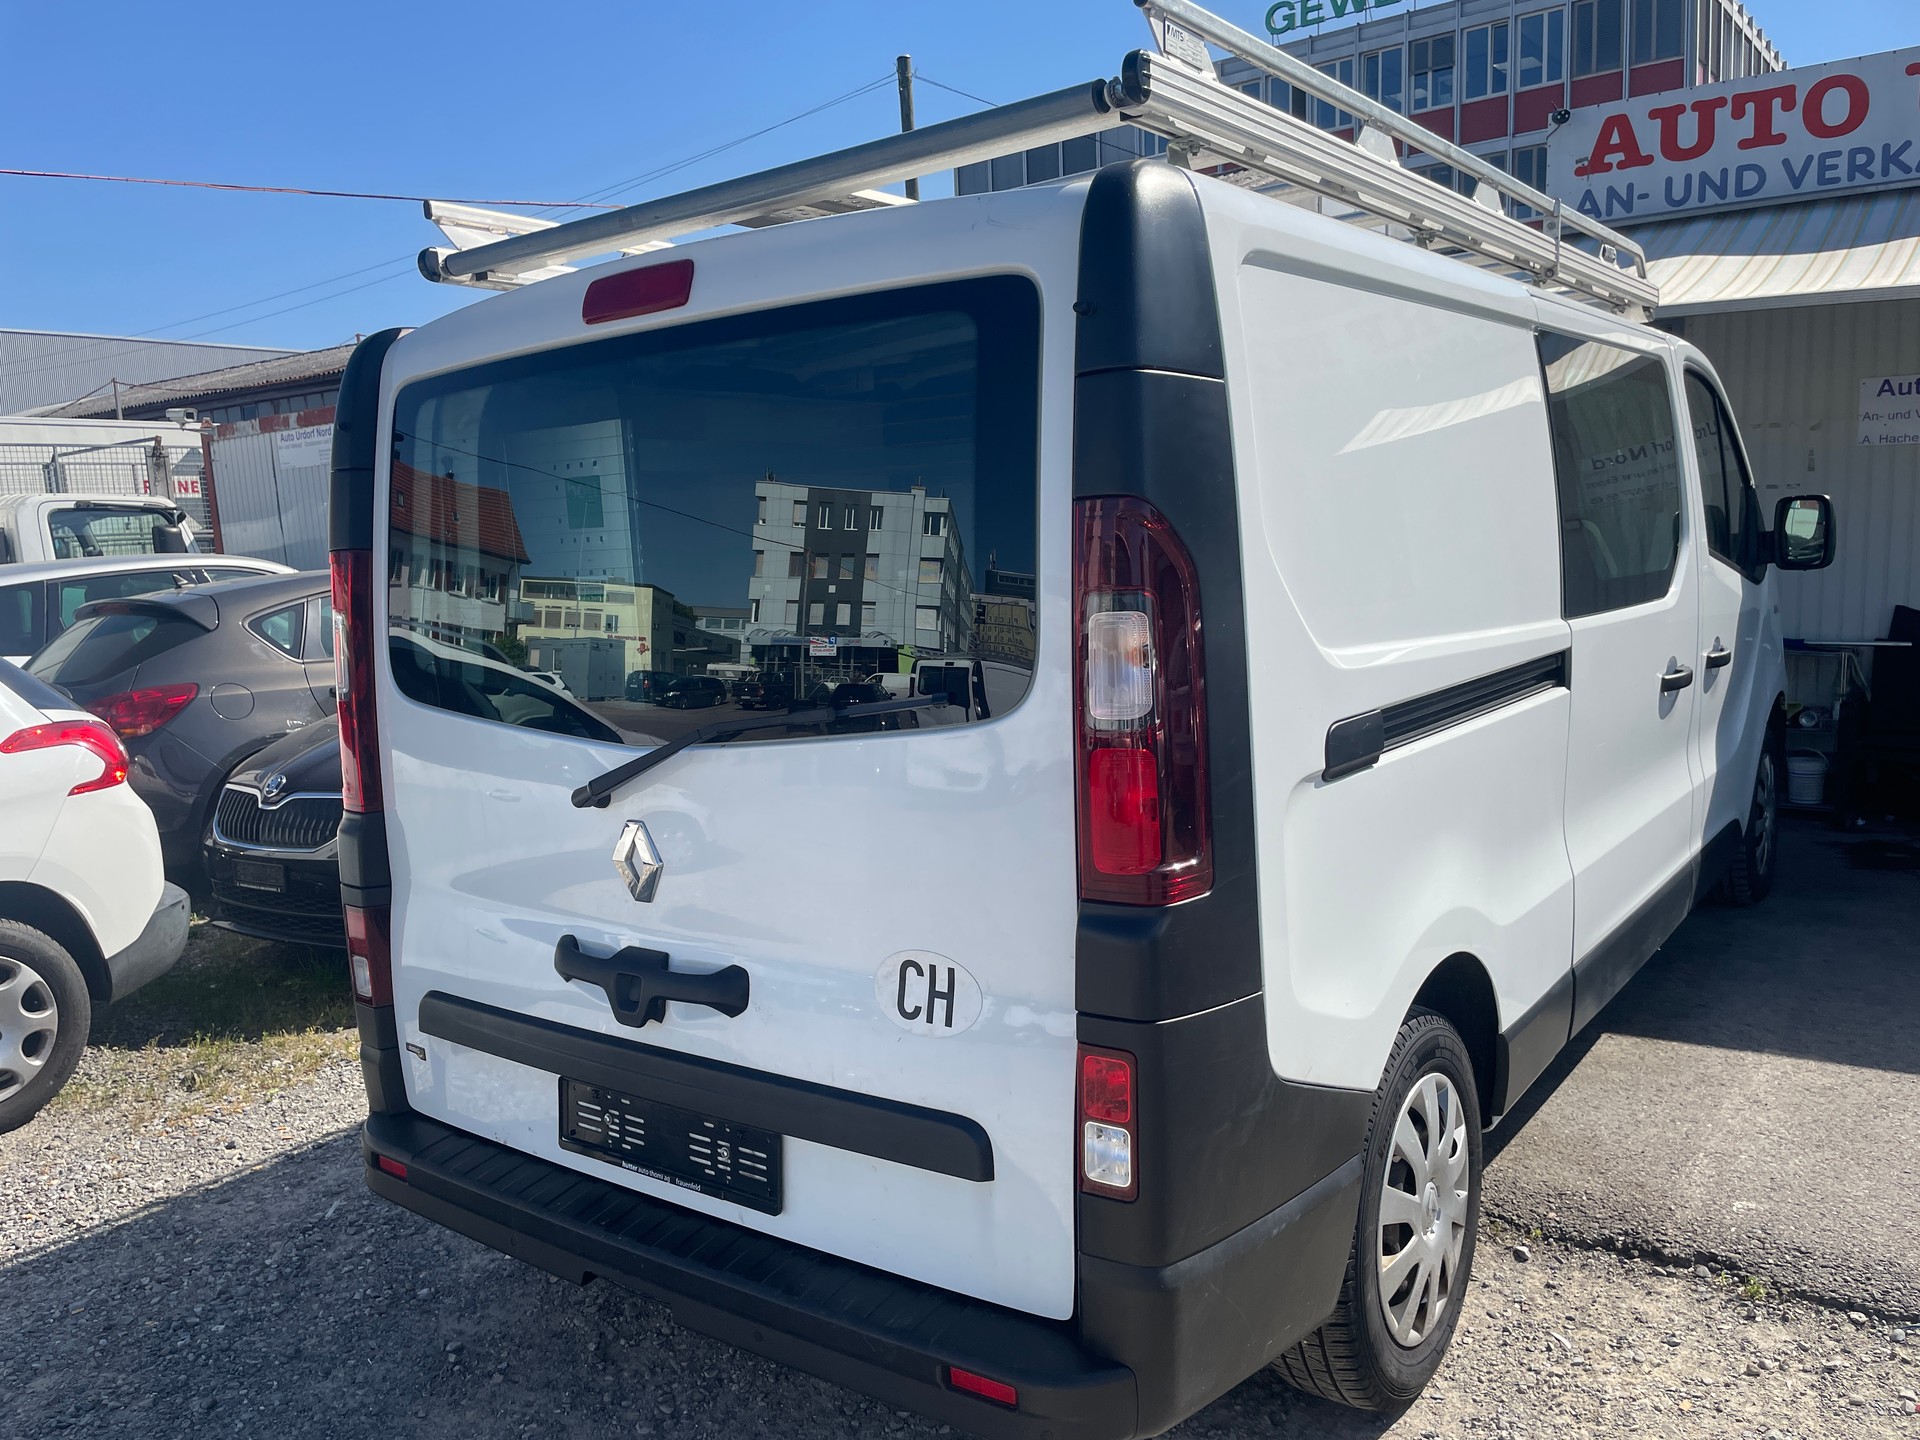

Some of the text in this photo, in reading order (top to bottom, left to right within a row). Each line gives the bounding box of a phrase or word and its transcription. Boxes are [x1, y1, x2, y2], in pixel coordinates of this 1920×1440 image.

[1265, 0, 1400, 35] GEW
[1574, 74, 1870, 177] AUTO
[1575, 139, 1920, 219] AN- UND VERK
[1862, 411, 1884, 421] An-
[1887, 409, 1911, 421] und
[280, 426, 332, 443] Auto Urdorf Nord
[897, 959, 956, 1029] CH
[621, 1160, 638, 1172] hutter
[638, 1166, 650, 1176] auto
[664, 1175, 671, 1184] ag
[675, 1177, 701, 1192] frauenfeld
